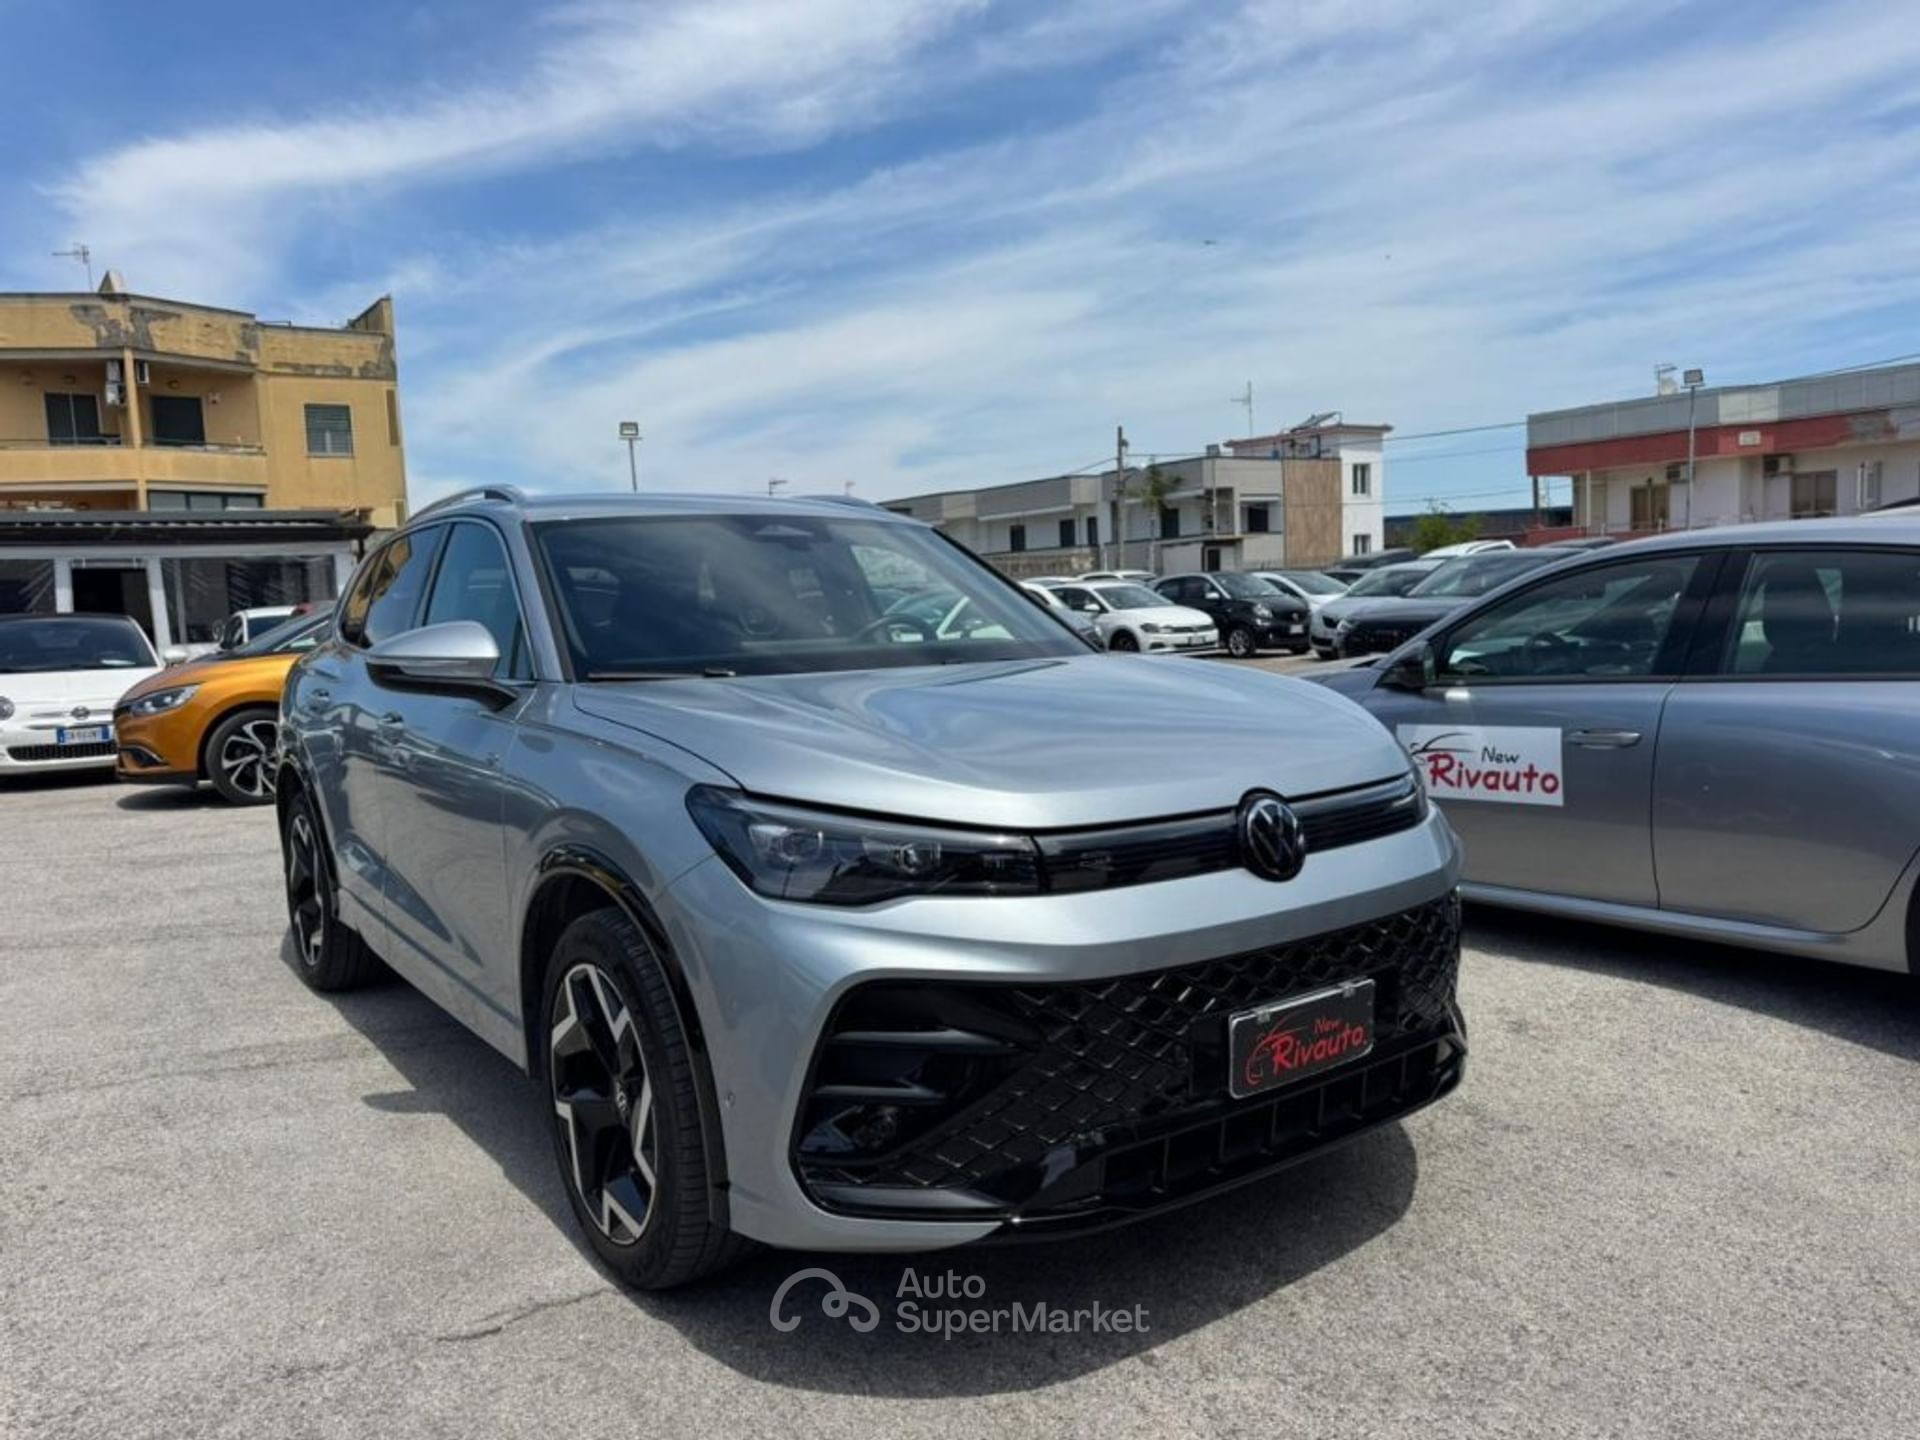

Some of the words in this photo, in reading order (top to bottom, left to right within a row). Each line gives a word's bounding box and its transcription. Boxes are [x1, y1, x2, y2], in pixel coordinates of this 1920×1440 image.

[1481, 746, 1520, 764] New
[1427, 752, 1560, 794] Rivauto
[1314, 1016, 1341, 1034] New
[1271, 1023, 1365, 1076] Rivauto
